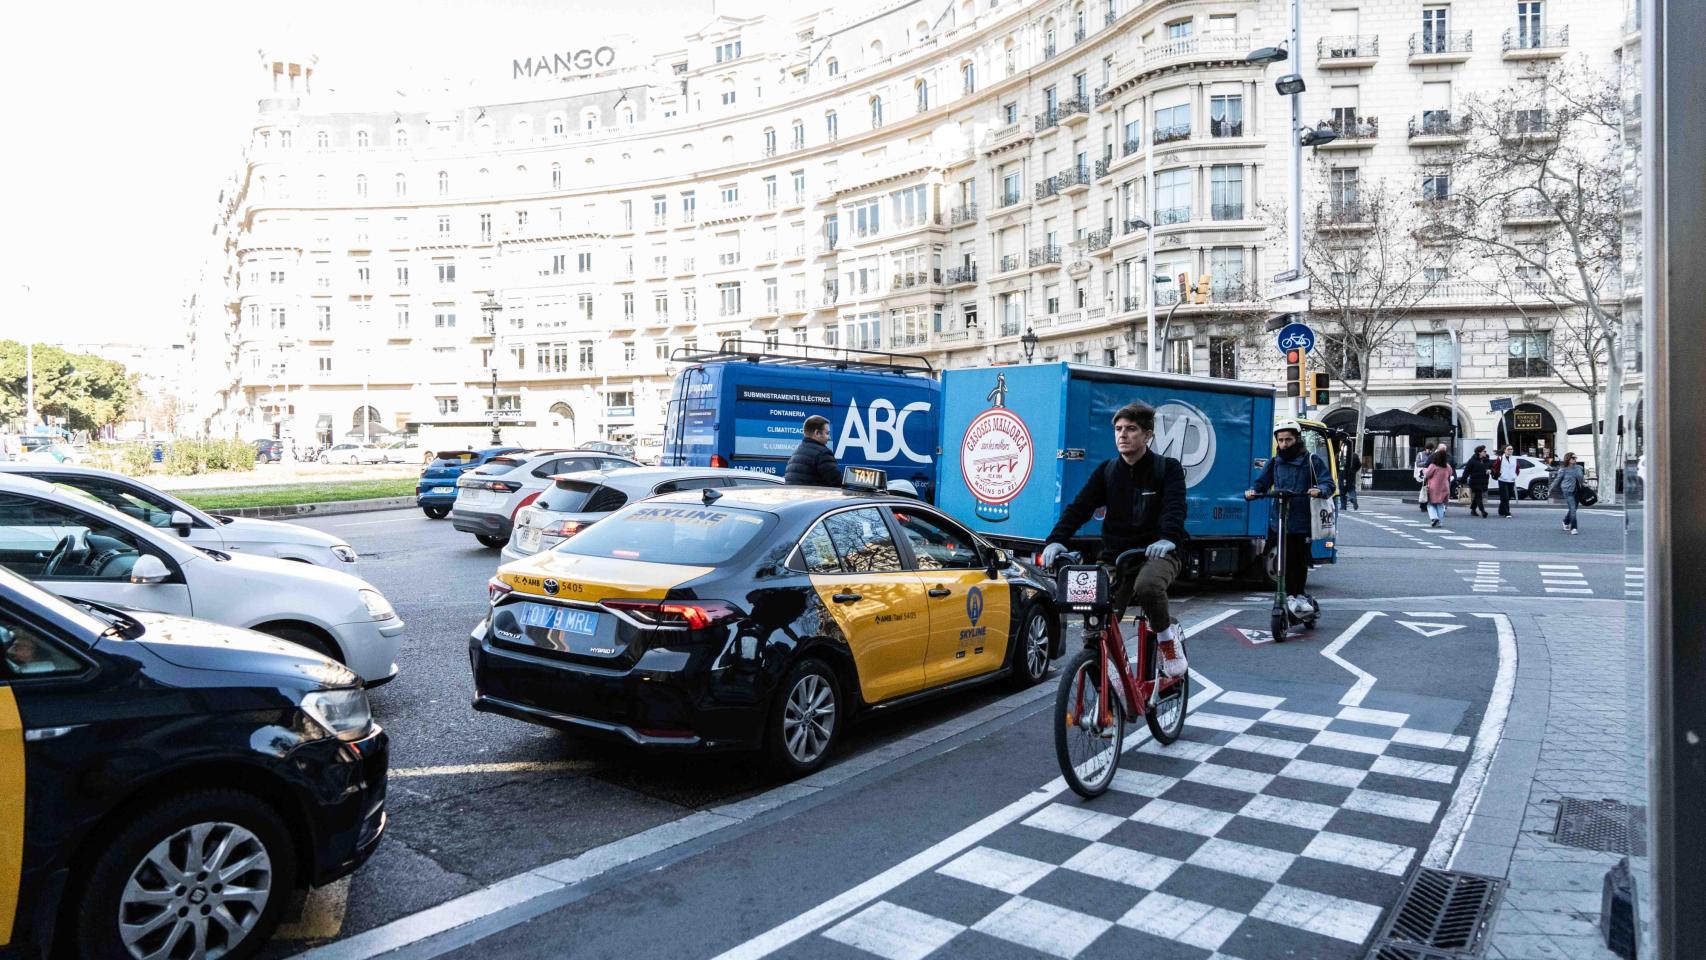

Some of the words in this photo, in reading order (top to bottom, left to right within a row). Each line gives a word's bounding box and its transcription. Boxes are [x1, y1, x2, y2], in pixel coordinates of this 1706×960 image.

[513, 46, 615, 80] MANGO
[743, 391, 800, 401] SUBMINISTRAMENTS
[769, 409, 806, 417] FONTANERIA
[834, 396, 934, 464] ABC
[967, 419, 992, 452] GASOSES
[992, 417, 1028, 453] MALLORCA
[750, 465, 777, 474] MOLINS
[855, 468, 876, 485] TAXI
[974, 480, 995, 495] MOLINS
[633, 507, 729, 522] SKYLINE
[528, 578, 541, 587] AMB
[562, 581, 584, 593] 5405
[565, 611, 593, 632] MRL
[959, 626, 987, 640] SKYLINE
